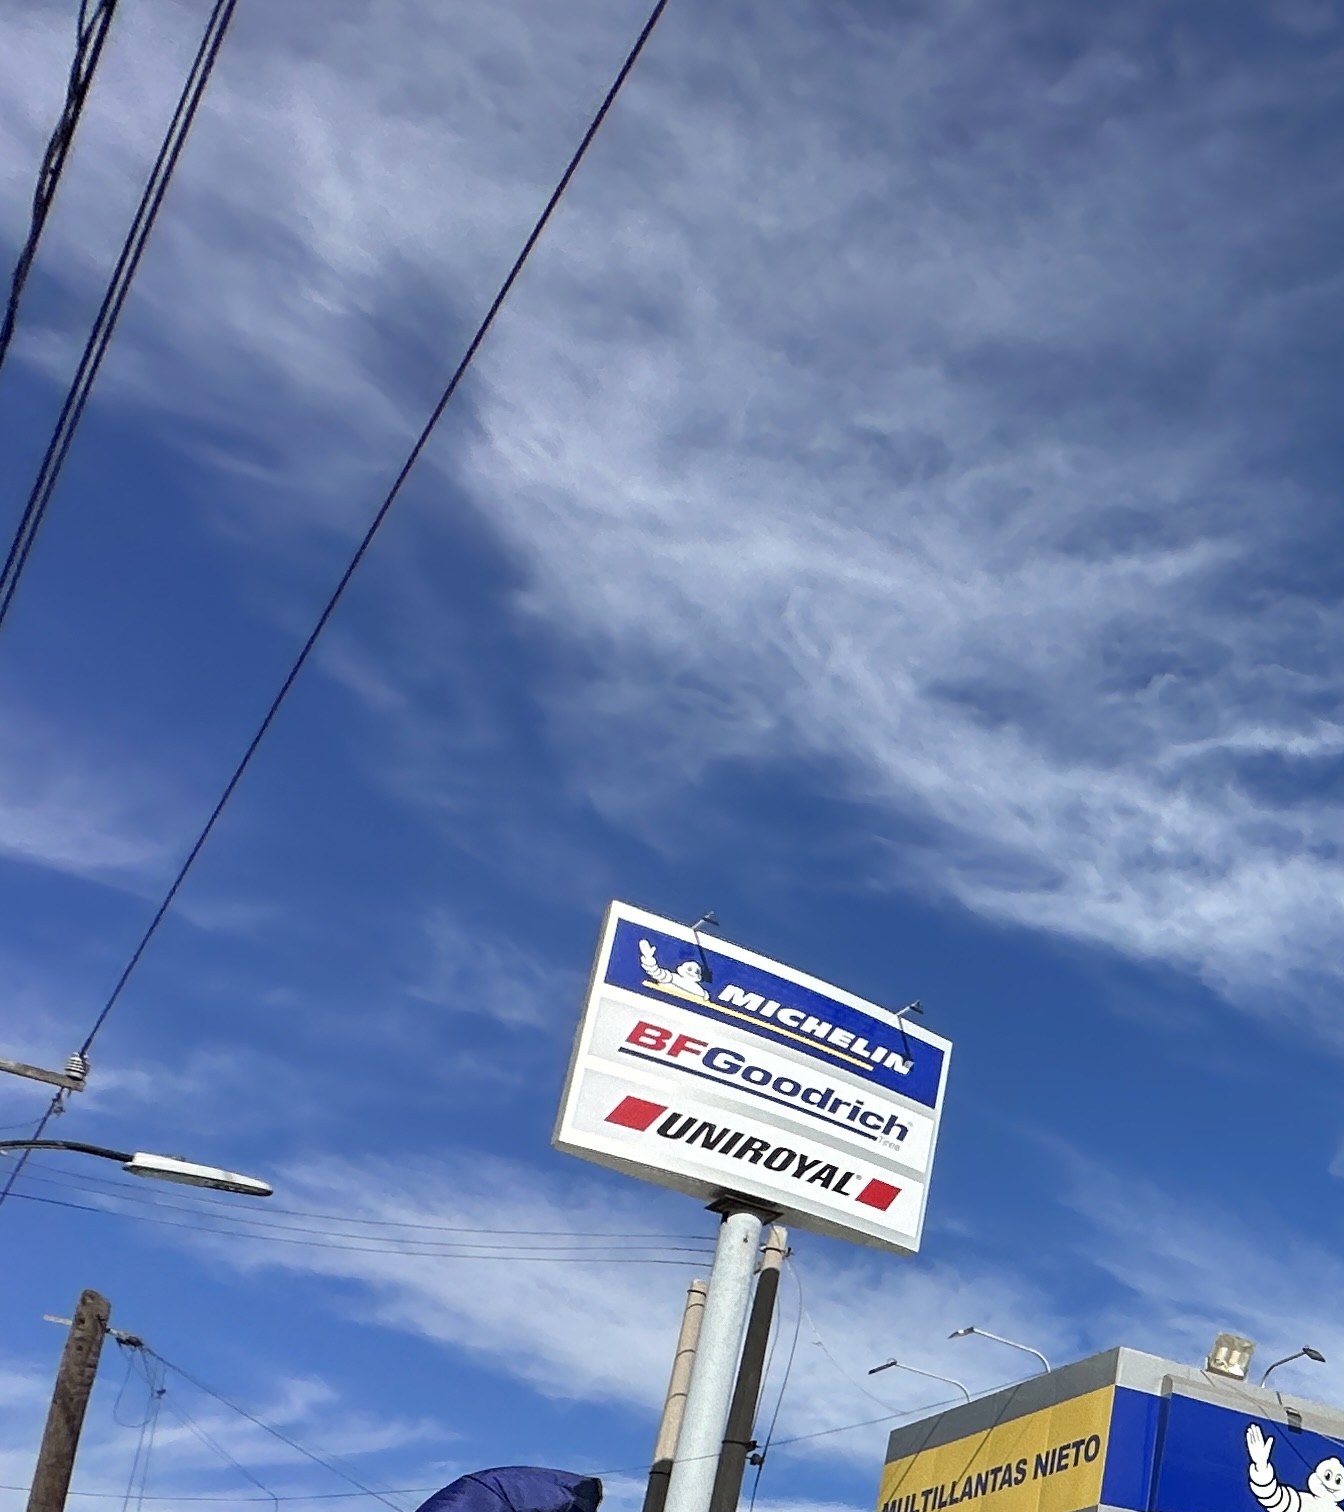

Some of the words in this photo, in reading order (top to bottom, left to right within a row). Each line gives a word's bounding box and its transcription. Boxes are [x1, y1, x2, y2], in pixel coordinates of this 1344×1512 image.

[717, 983, 914, 1076] MICHELIN
[624, 1020, 910, 1142] BFGoodrich
[656, 1111, 856, 1197] UNIROYAL
[1032, 1434, 1101, 1480] NIETO
